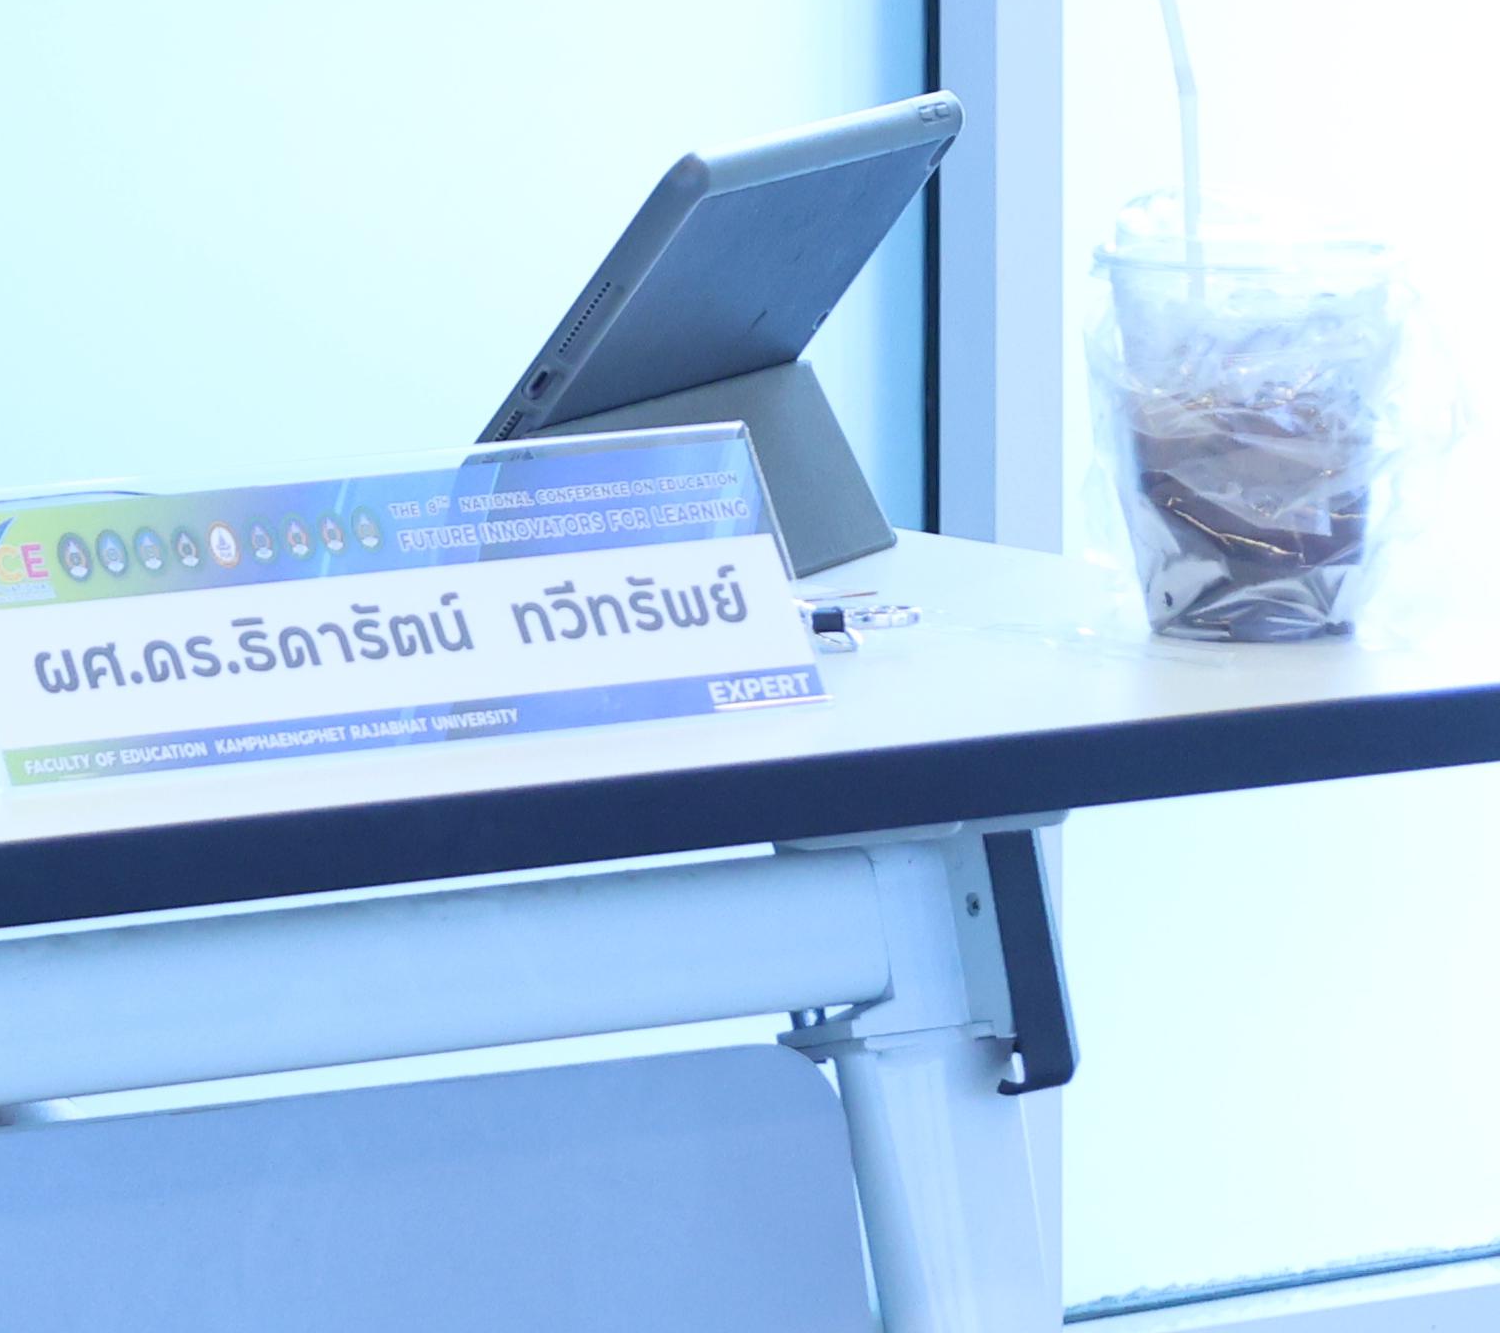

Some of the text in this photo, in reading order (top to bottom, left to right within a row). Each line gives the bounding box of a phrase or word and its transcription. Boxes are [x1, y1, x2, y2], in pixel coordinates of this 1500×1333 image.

[389, 500, 419, 518] THE
[460, 490, 534, 512] NATIONAL
[535, 482, 629, 505] CONFERENCE
[632, 479, 654, 494] ON
[657, 472, 738, 493] EDUCATION
[399, 497, 749, 551] FUTURE INNOVATORS FOR LEARNING
[33, 563, 749, 695] ผศ.ดร.ธิดารัตน์ ทวีทรัพย์
[707, 671, 812, 705] EXPERT
[24, 707, 519, 776] FACULTY OF EDUCATION KAMPHAENGPHET RAJABHAT UNIVERSITY
